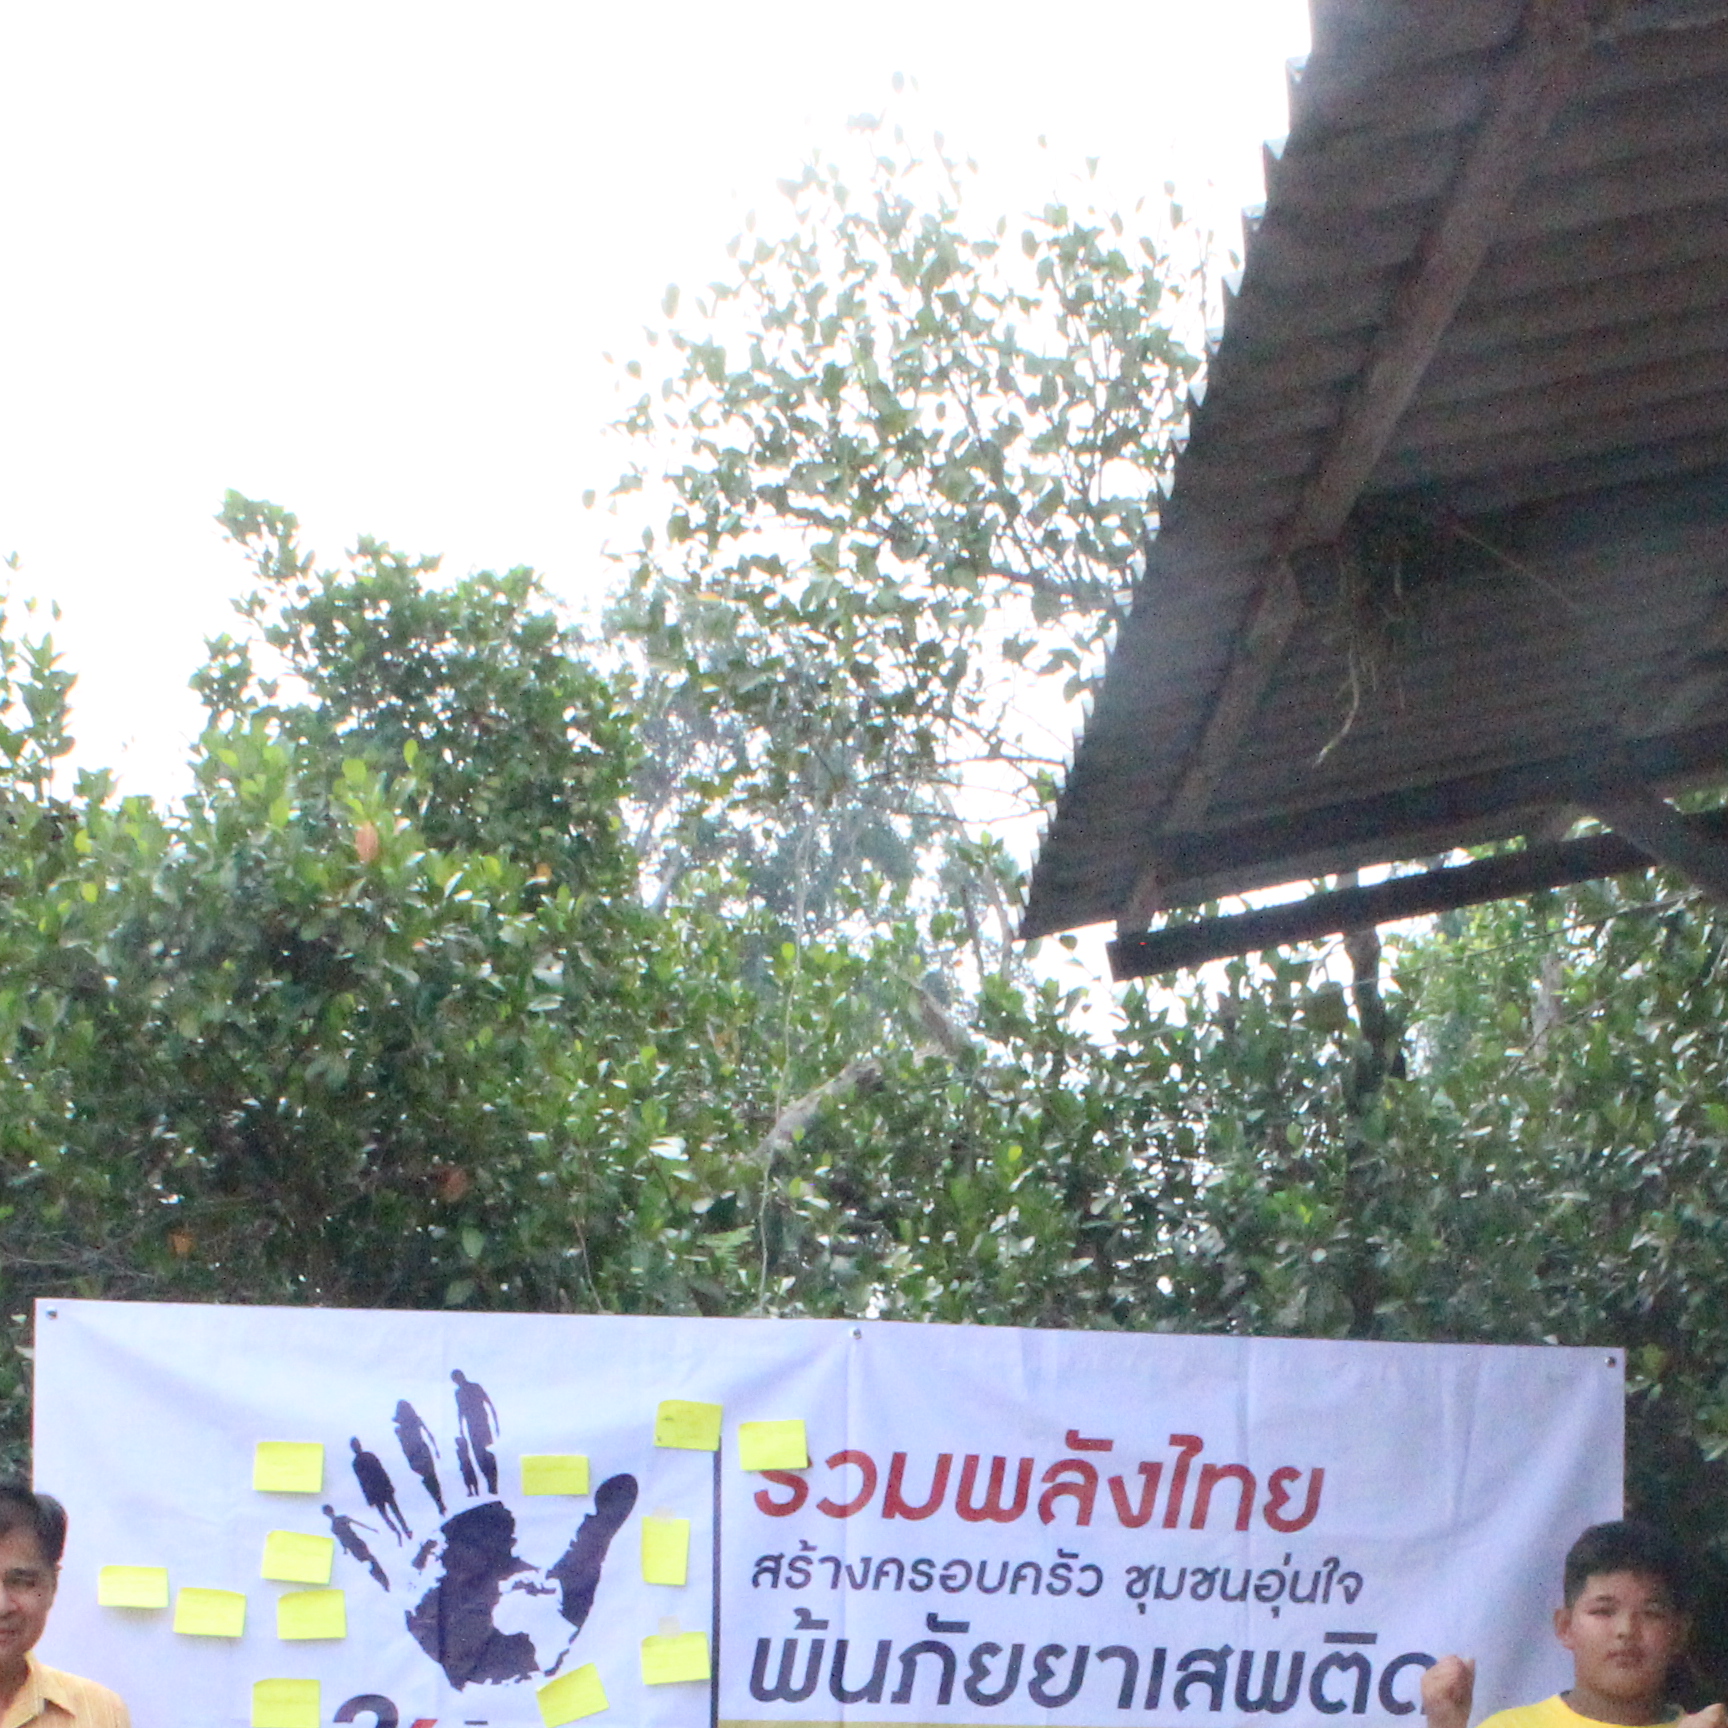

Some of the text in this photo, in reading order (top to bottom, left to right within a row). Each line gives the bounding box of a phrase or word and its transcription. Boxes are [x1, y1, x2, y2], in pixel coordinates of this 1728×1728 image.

[751, 1538, 1365, 1620] สร้างครอบครัว ชุมชนอุ่นใจ
